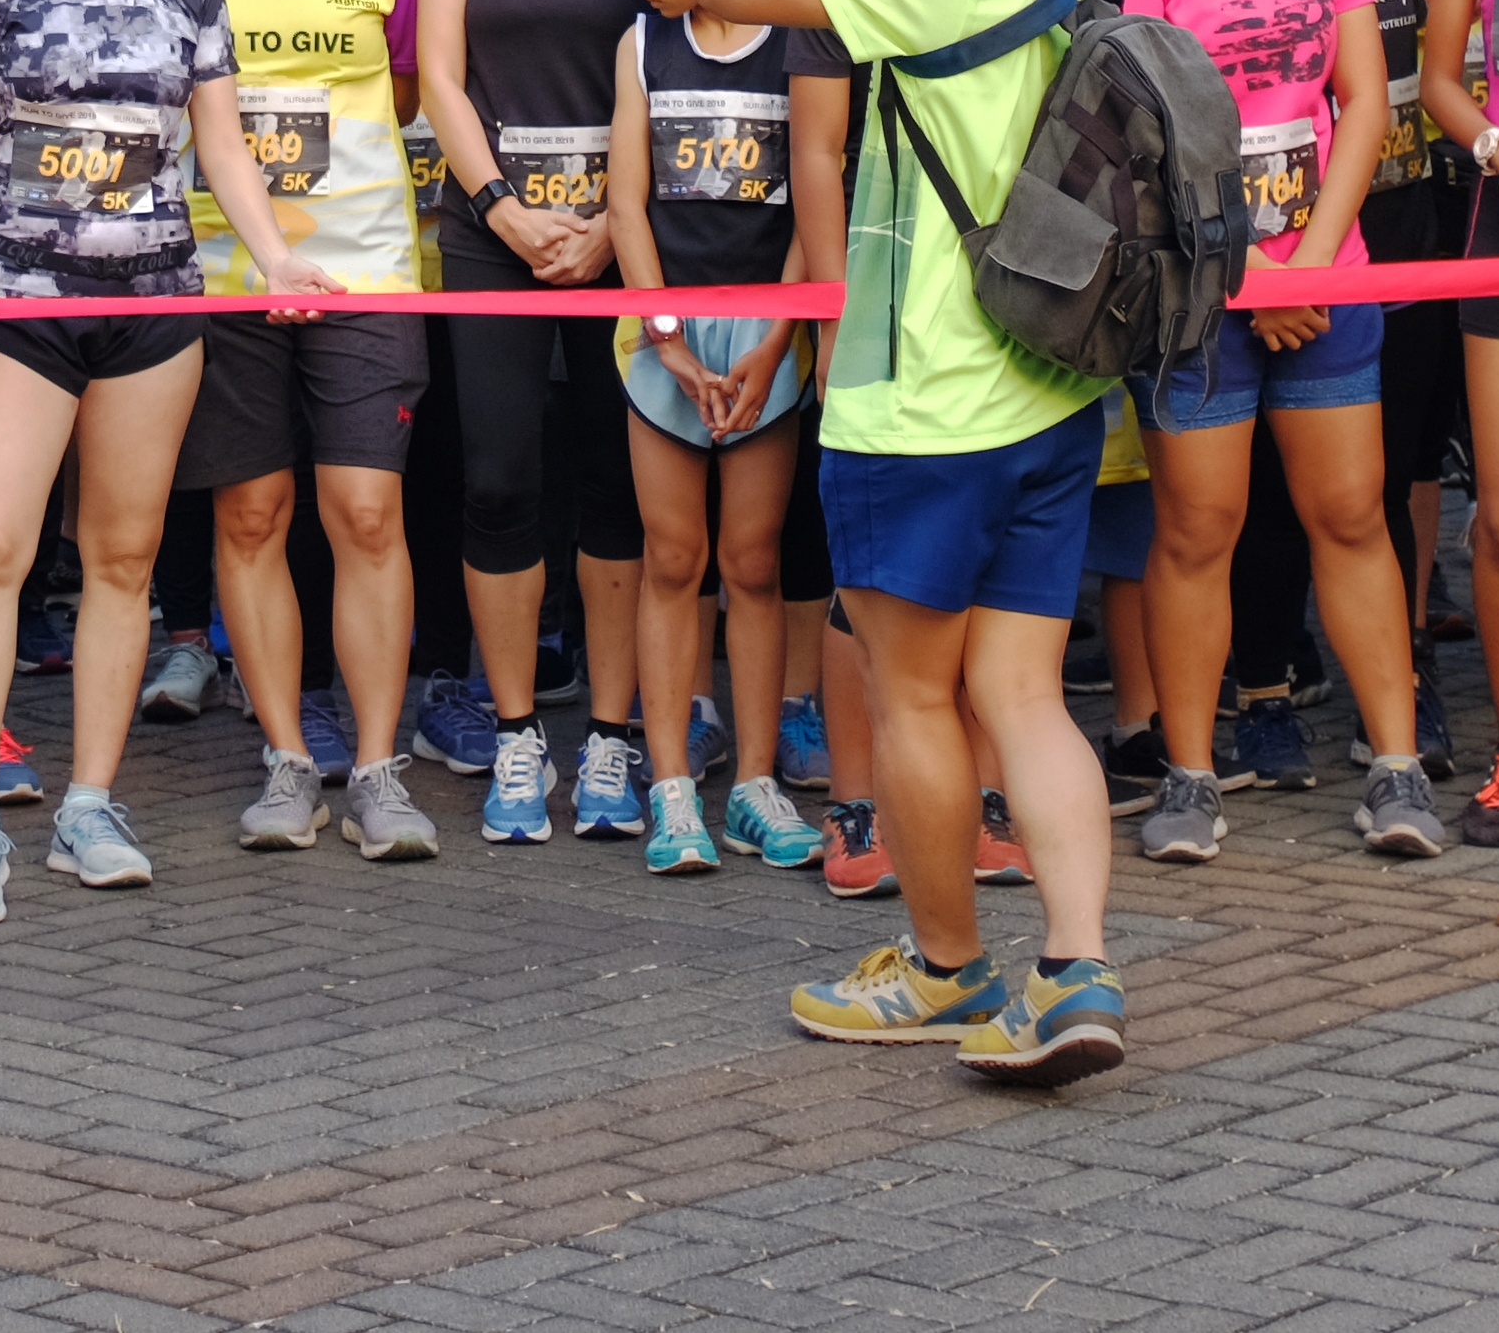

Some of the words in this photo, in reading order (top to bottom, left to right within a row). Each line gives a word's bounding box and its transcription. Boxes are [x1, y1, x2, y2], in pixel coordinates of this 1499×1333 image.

[245, 31, 282, 53] TO
[292, 31, 354, 54] GIVE
[38, 144, 126, 183] 5001
[675, 137, 760, 171] 5170
[281, 172, 311, 192] 5K
[524, 173, 608, 206] 5627
[739, 179, 769, 200] 5K
[102, 191, 131, 210] 5K
